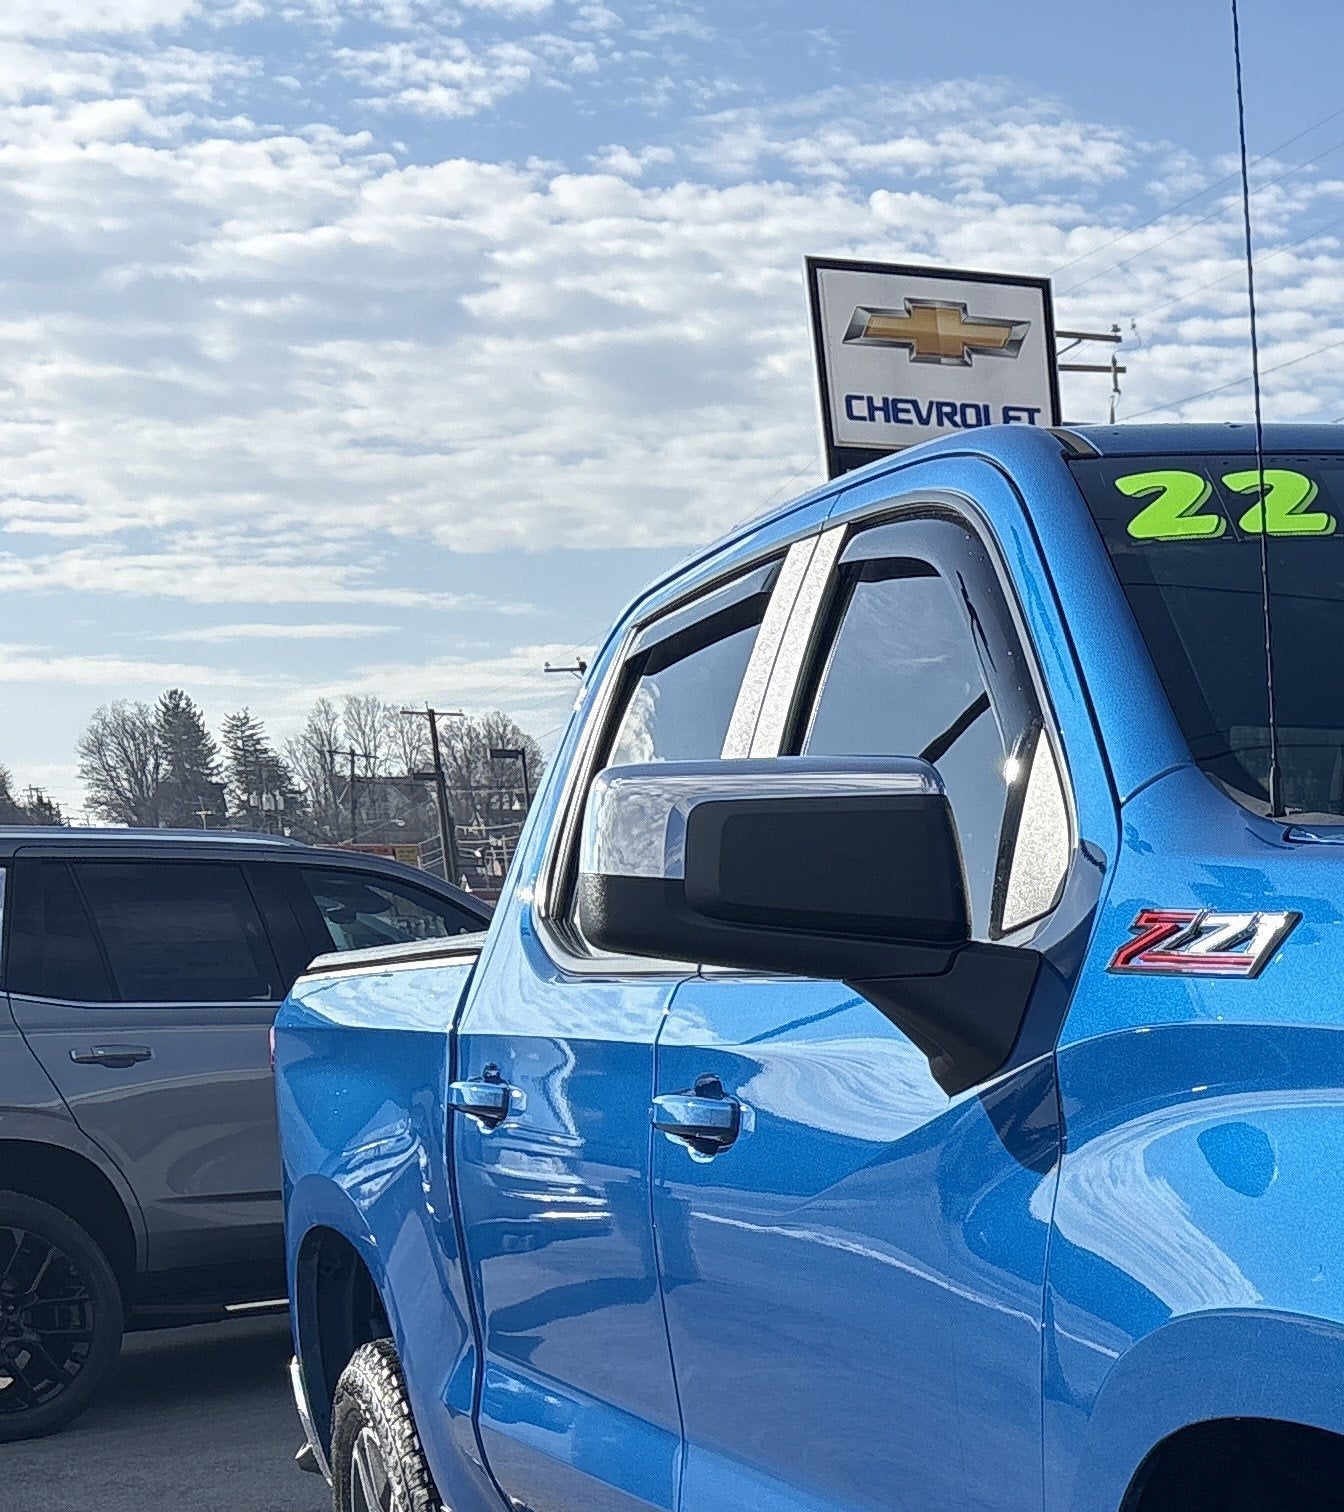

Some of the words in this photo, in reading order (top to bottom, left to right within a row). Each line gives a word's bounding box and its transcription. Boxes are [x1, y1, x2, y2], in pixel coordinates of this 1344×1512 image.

[844, 394, 1041, 428] CHEVROLET
[1114, 469, 1337, 541] 22
[1104, 908, 1303, 979] Z71
